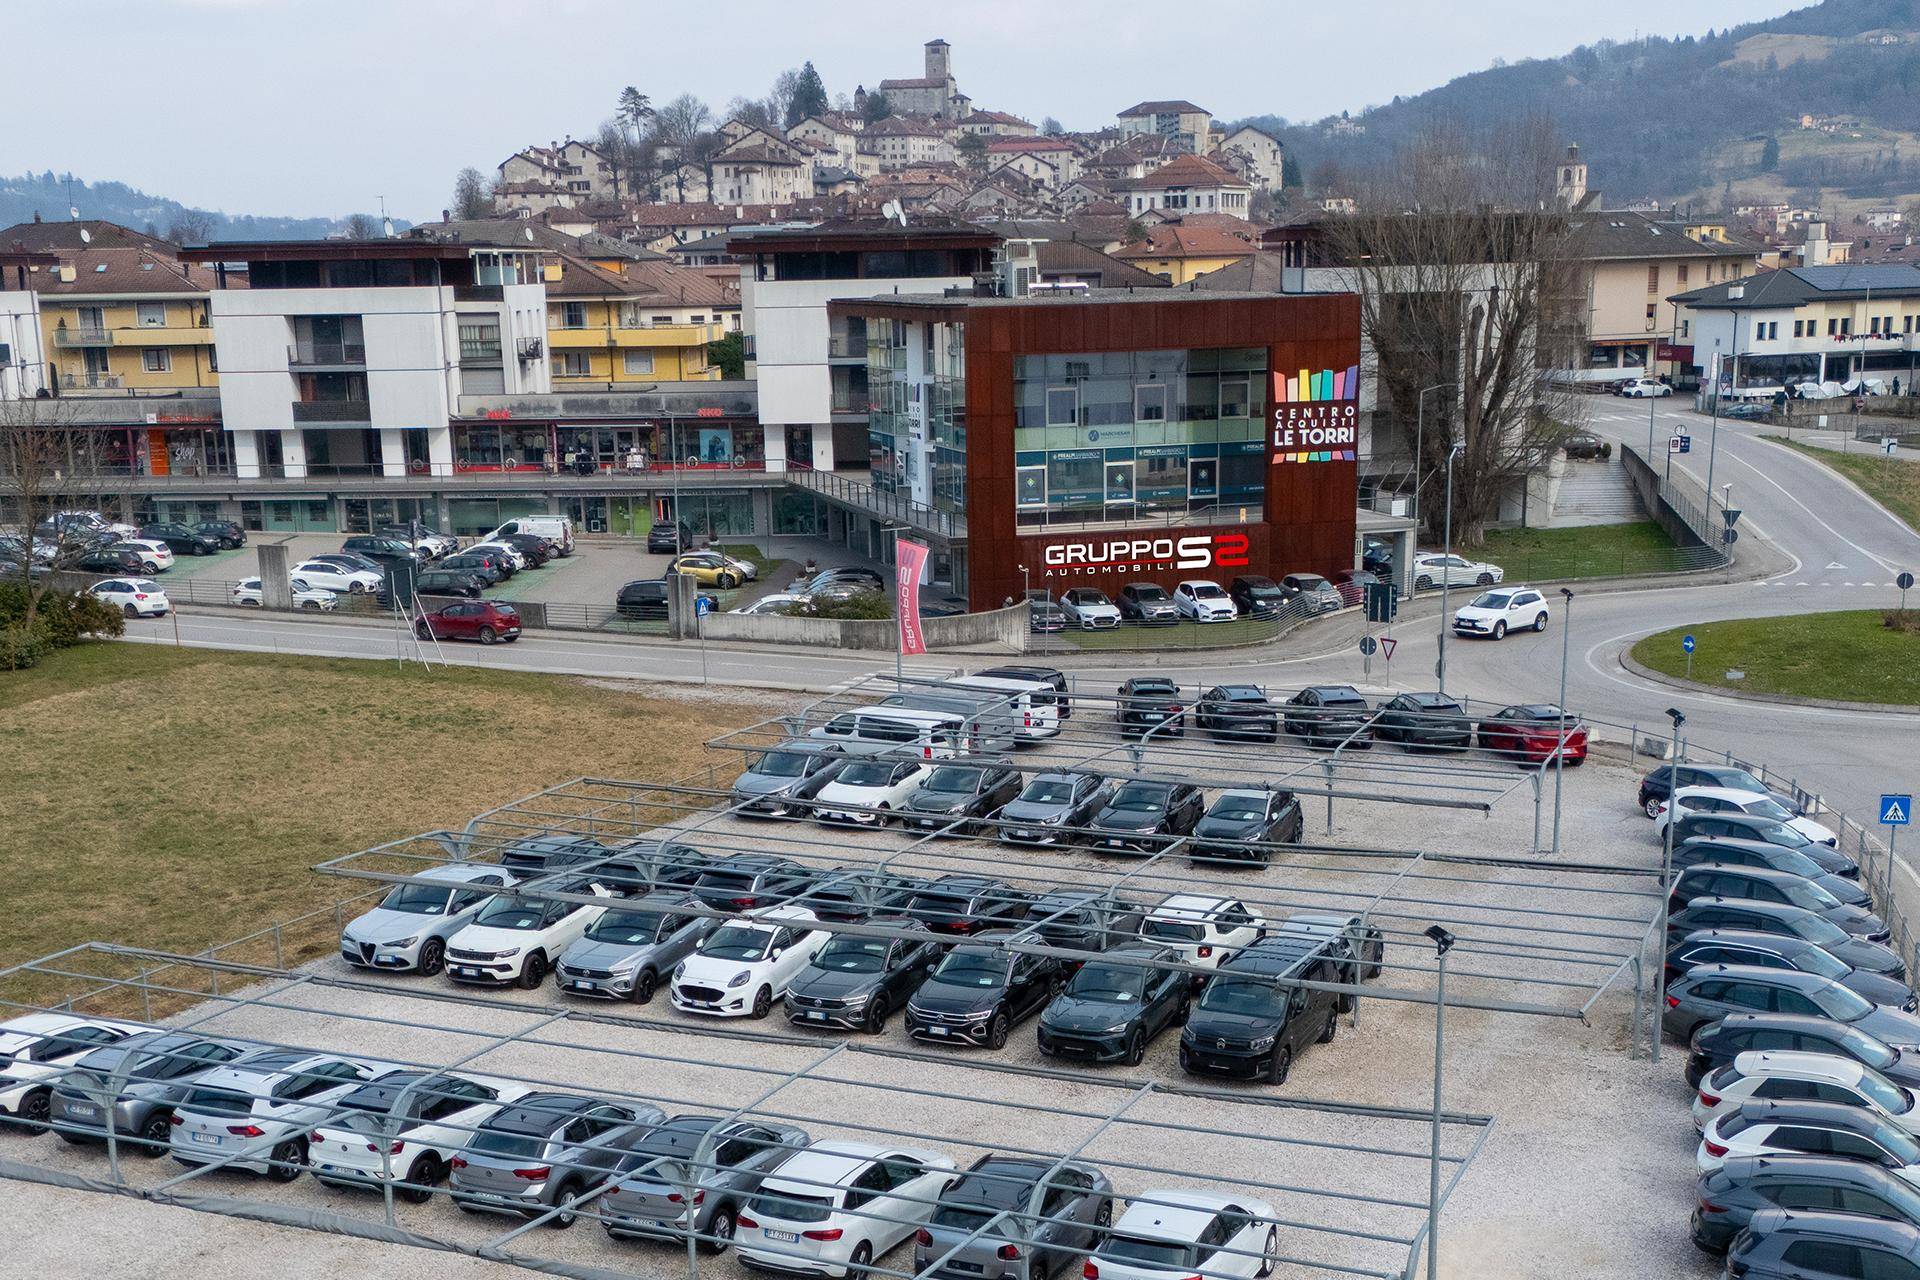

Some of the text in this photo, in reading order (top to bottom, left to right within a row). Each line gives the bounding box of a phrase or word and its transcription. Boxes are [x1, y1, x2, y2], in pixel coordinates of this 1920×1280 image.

[1275, 405, 1355, 420] CENTRO
[1275, 417, 1354, 430] ACQUISTI
[1274, 427, 1355, 447] LE TORRI
[1045, 538, 1173, 565] GRUPPO
[1045, 562, 1173, 577] AUTOMOBILI
